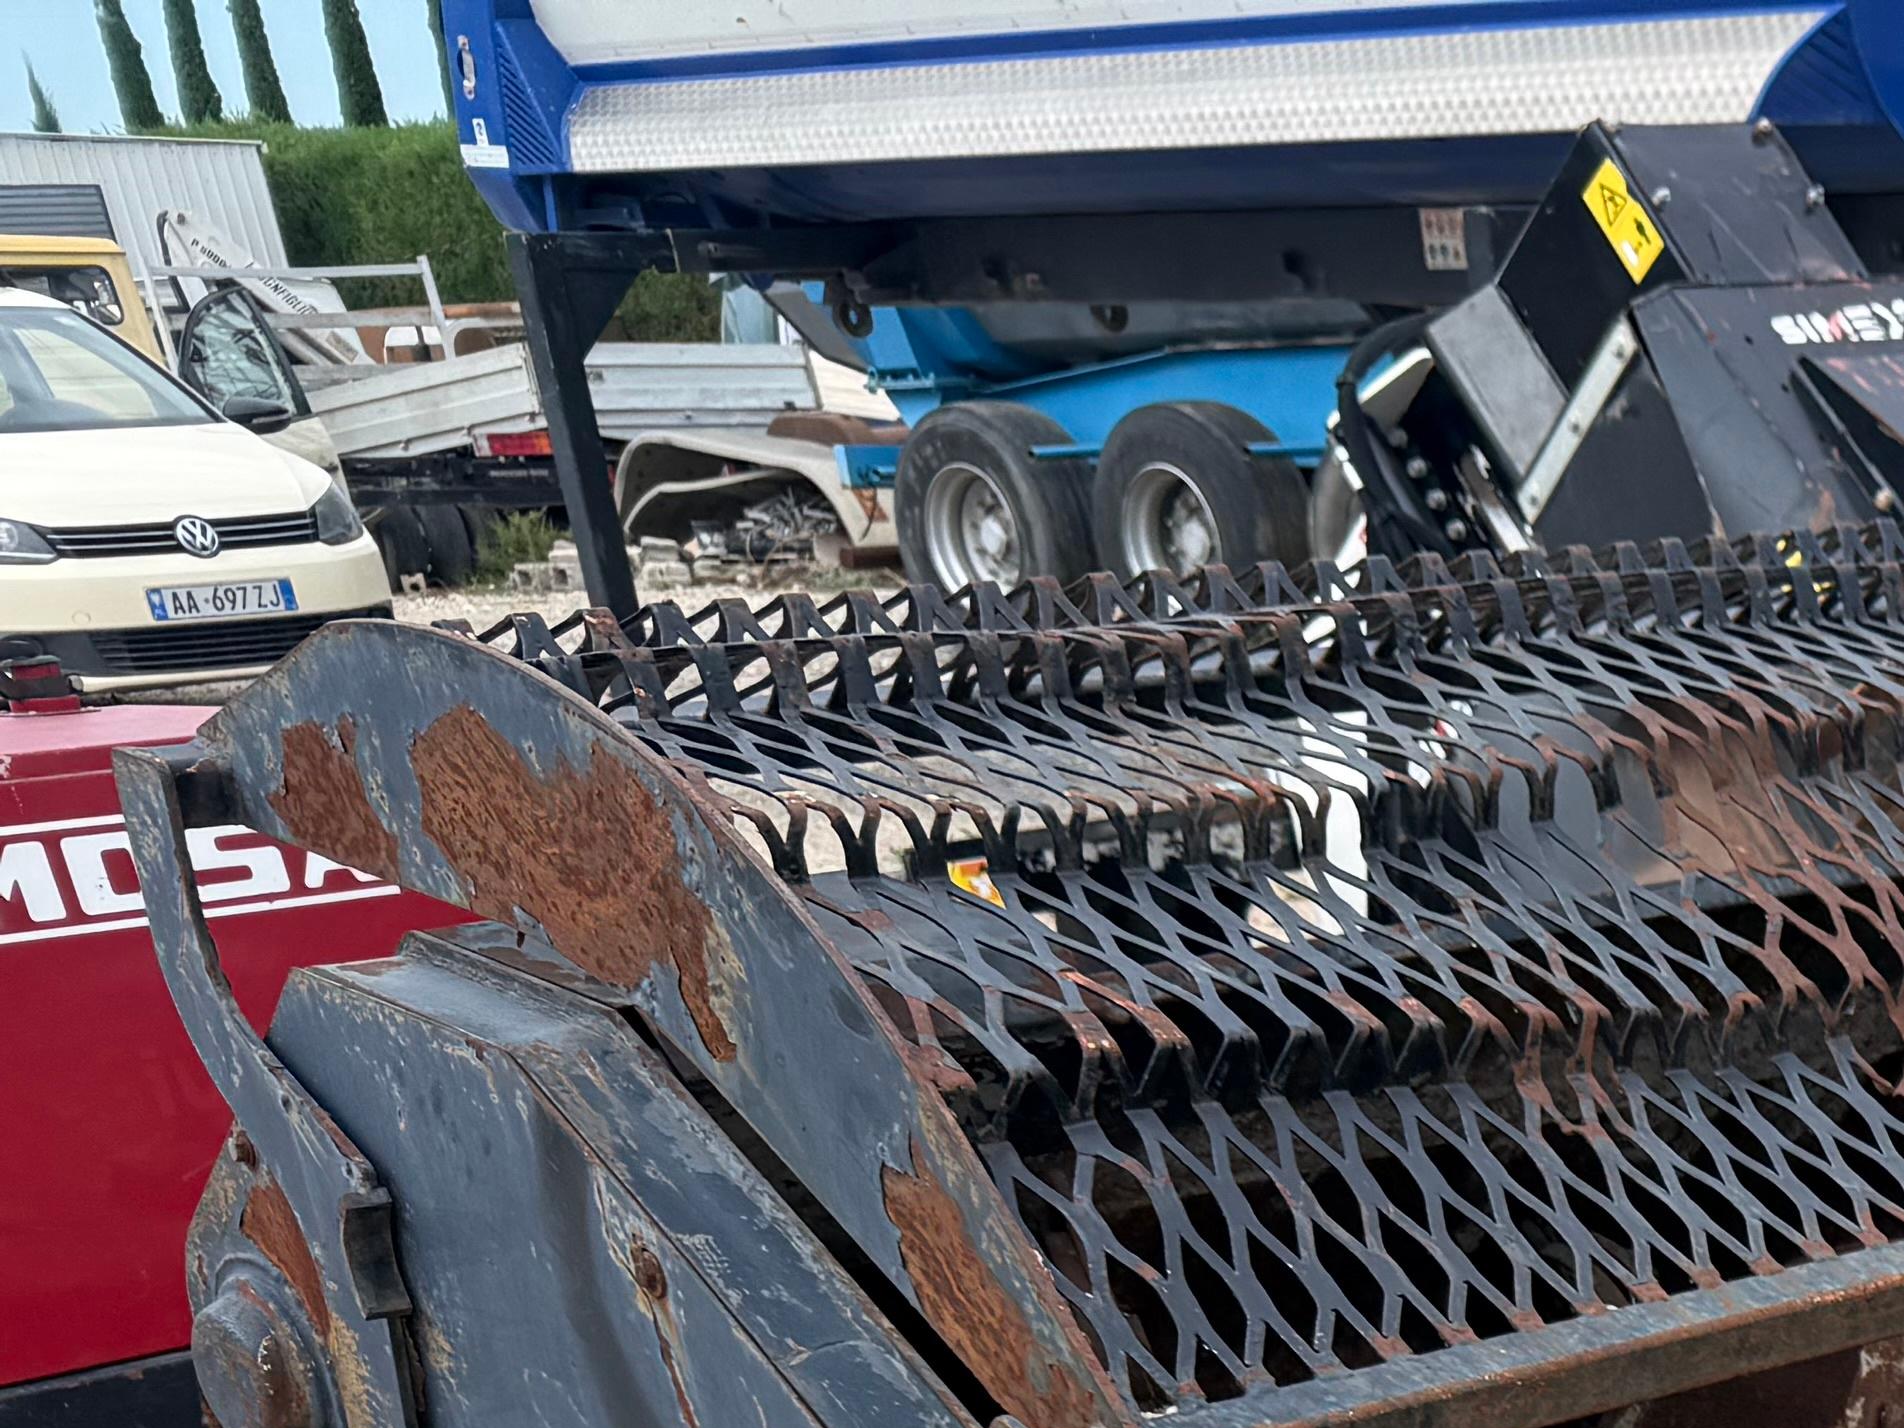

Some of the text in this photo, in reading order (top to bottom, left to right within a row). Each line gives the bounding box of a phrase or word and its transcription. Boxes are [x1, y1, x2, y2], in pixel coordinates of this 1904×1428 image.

[172, 584, 281, 616] AA 697 ZJ
